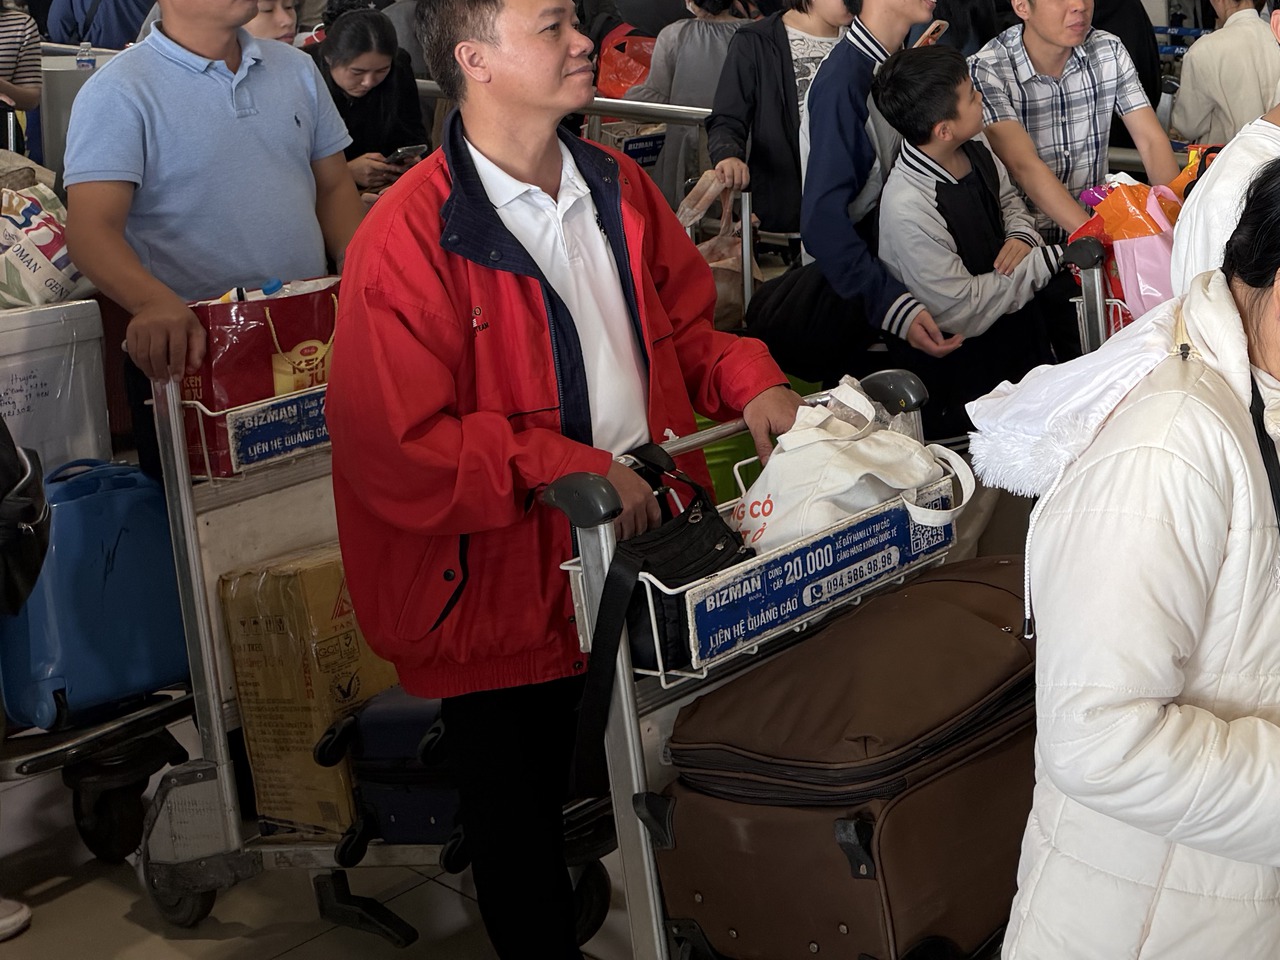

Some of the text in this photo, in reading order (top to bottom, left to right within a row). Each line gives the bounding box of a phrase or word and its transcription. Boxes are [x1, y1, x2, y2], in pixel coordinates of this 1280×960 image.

[292, 356, 327, 375] KEN
[315, 424, 330, 440] CÁ
[749, 493, 774, 519] CÓ
[705, 544, 834, 613] BIZMAN CUNG 20.000
[826, 552, 893, 594] 094.986.98.98
[709, 595, 799, 649] LIÊN HỆ QUẢNG CÁO
